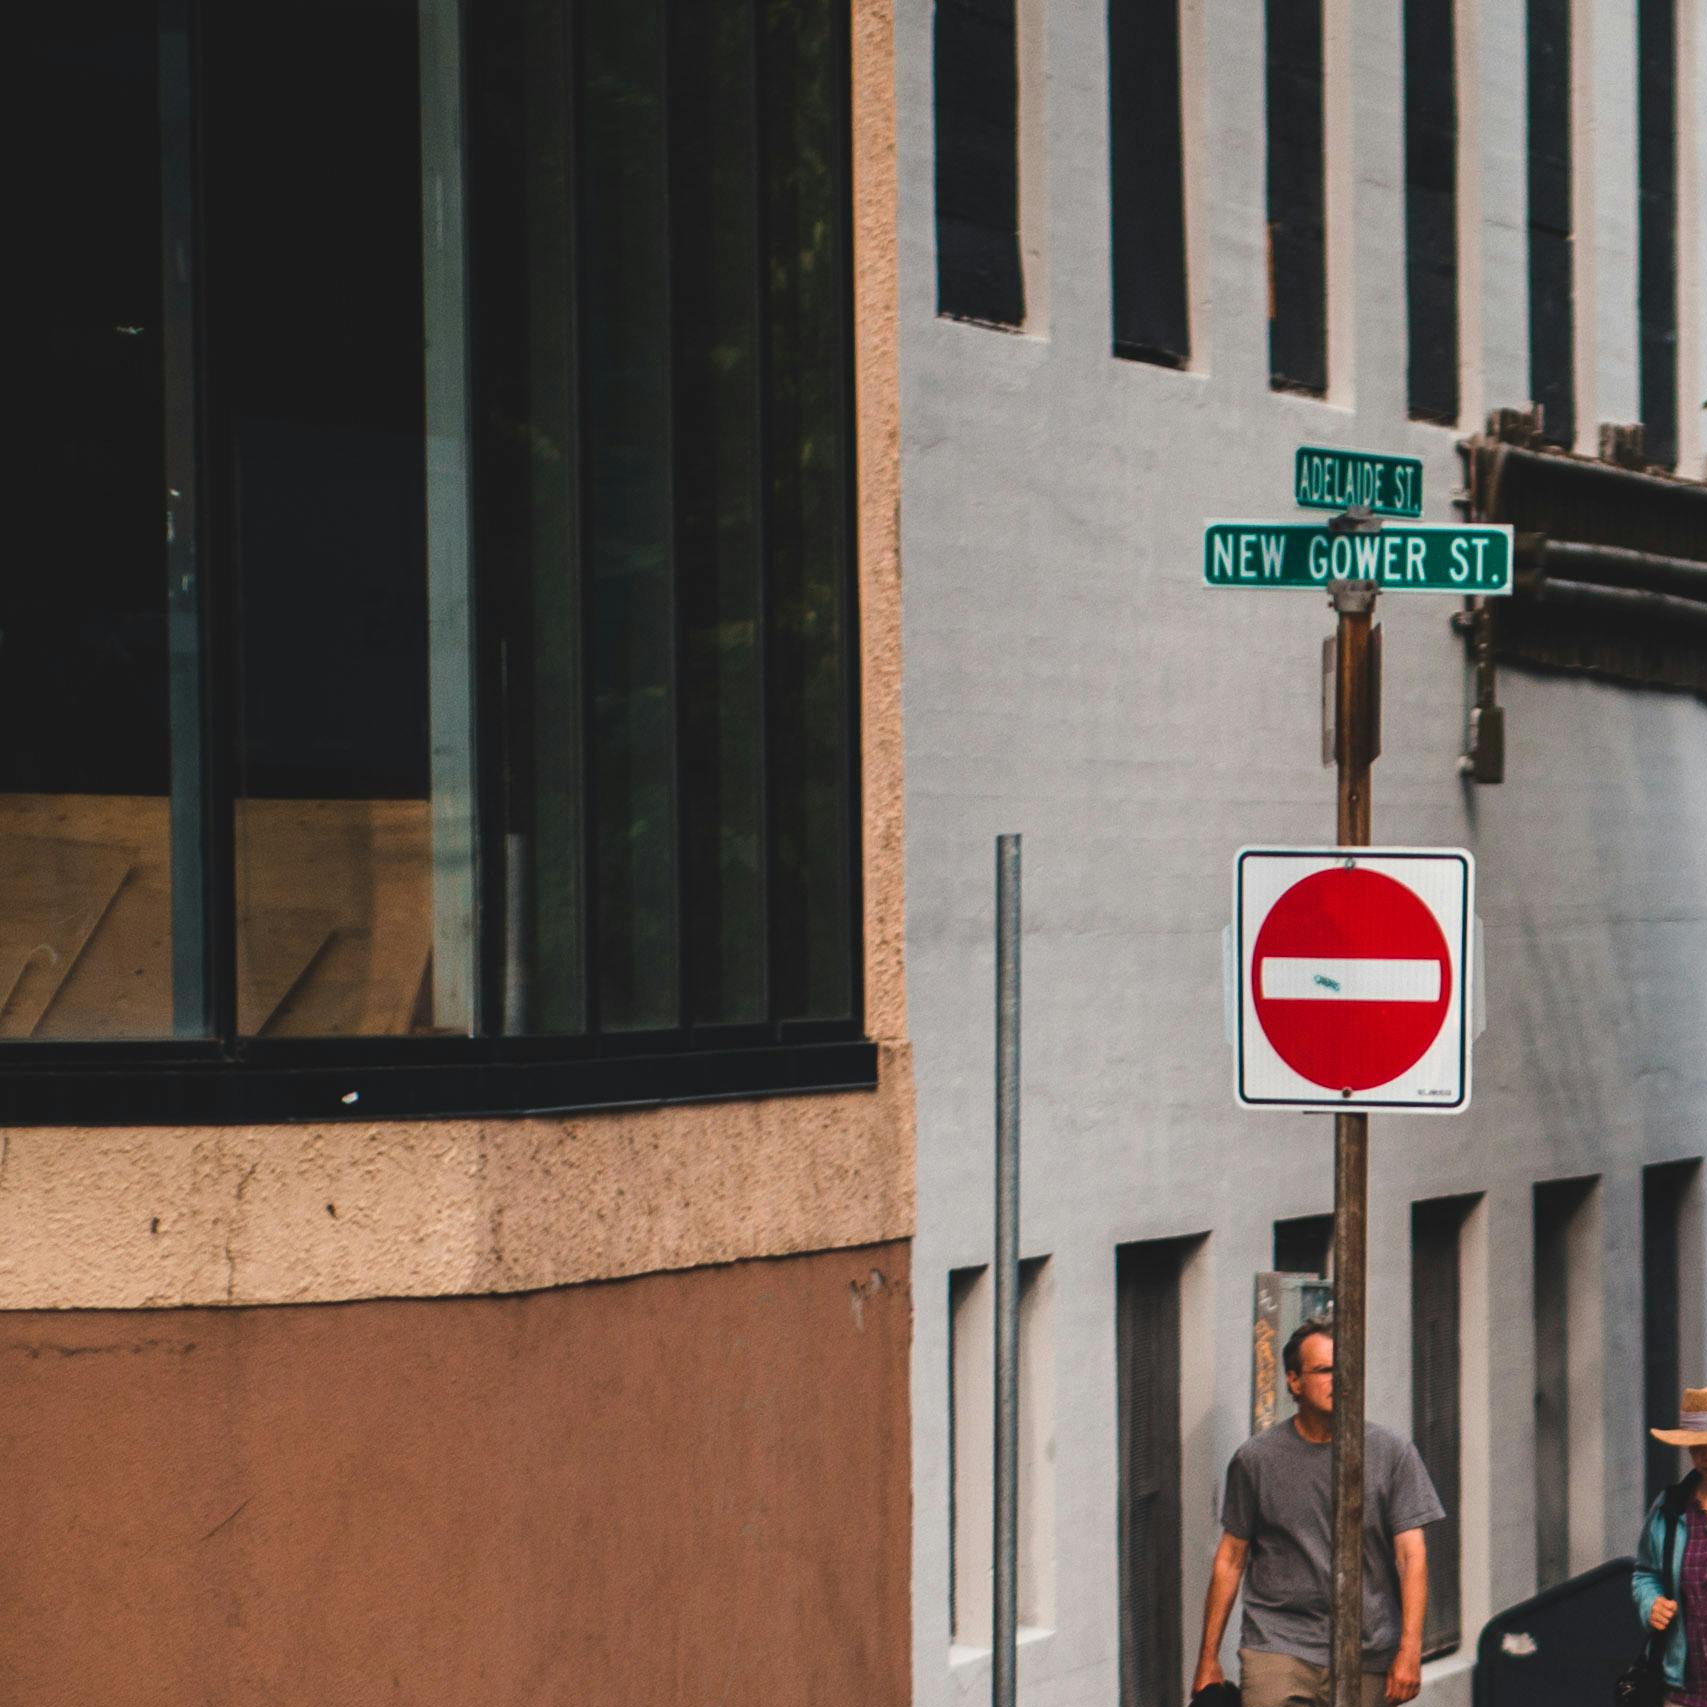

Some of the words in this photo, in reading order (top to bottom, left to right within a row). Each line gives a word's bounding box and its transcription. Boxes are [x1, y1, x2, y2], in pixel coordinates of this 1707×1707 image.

[1300, 455, 1384, 507] ADELAIDE
[1395, 465, 1419, 512] ST.
[1213, 533, 1286, 578] NEW
[1308, 534, 1427, 580] GOWER
[1449, 537, 1500, 582] ST.
